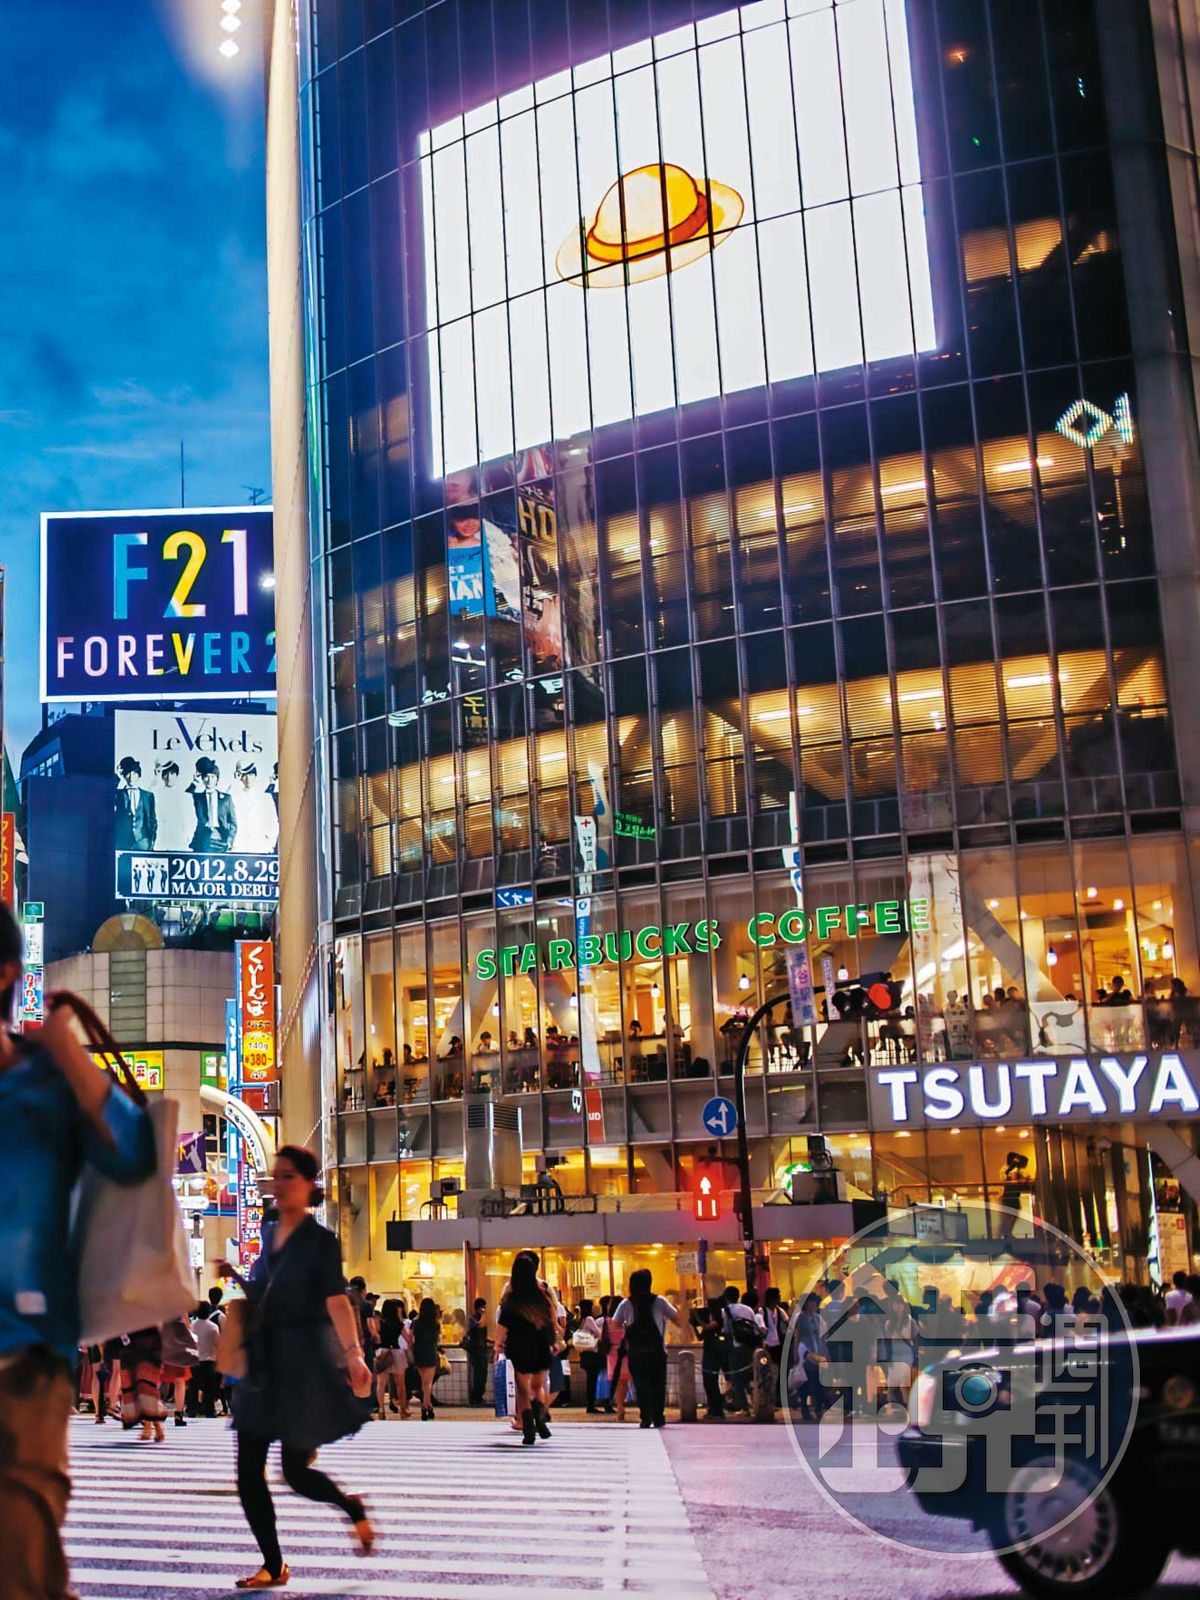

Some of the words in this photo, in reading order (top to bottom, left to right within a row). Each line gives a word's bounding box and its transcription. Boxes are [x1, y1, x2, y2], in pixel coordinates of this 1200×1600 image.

[112, 529, 248, 620] F21
[56, 631, 252, 678] FOREVER
[171, 858, 279, 883] 2012.8.29
[171, 881, 227, 897] MAJOR
[476, 919, 722, 981] STARBUCKS
[747, 898, 931, 947] COFFEE
[246, 946, 268, 1017] くいしんぼ
[877, 1053, 1200, 1121] TSUTAYA
